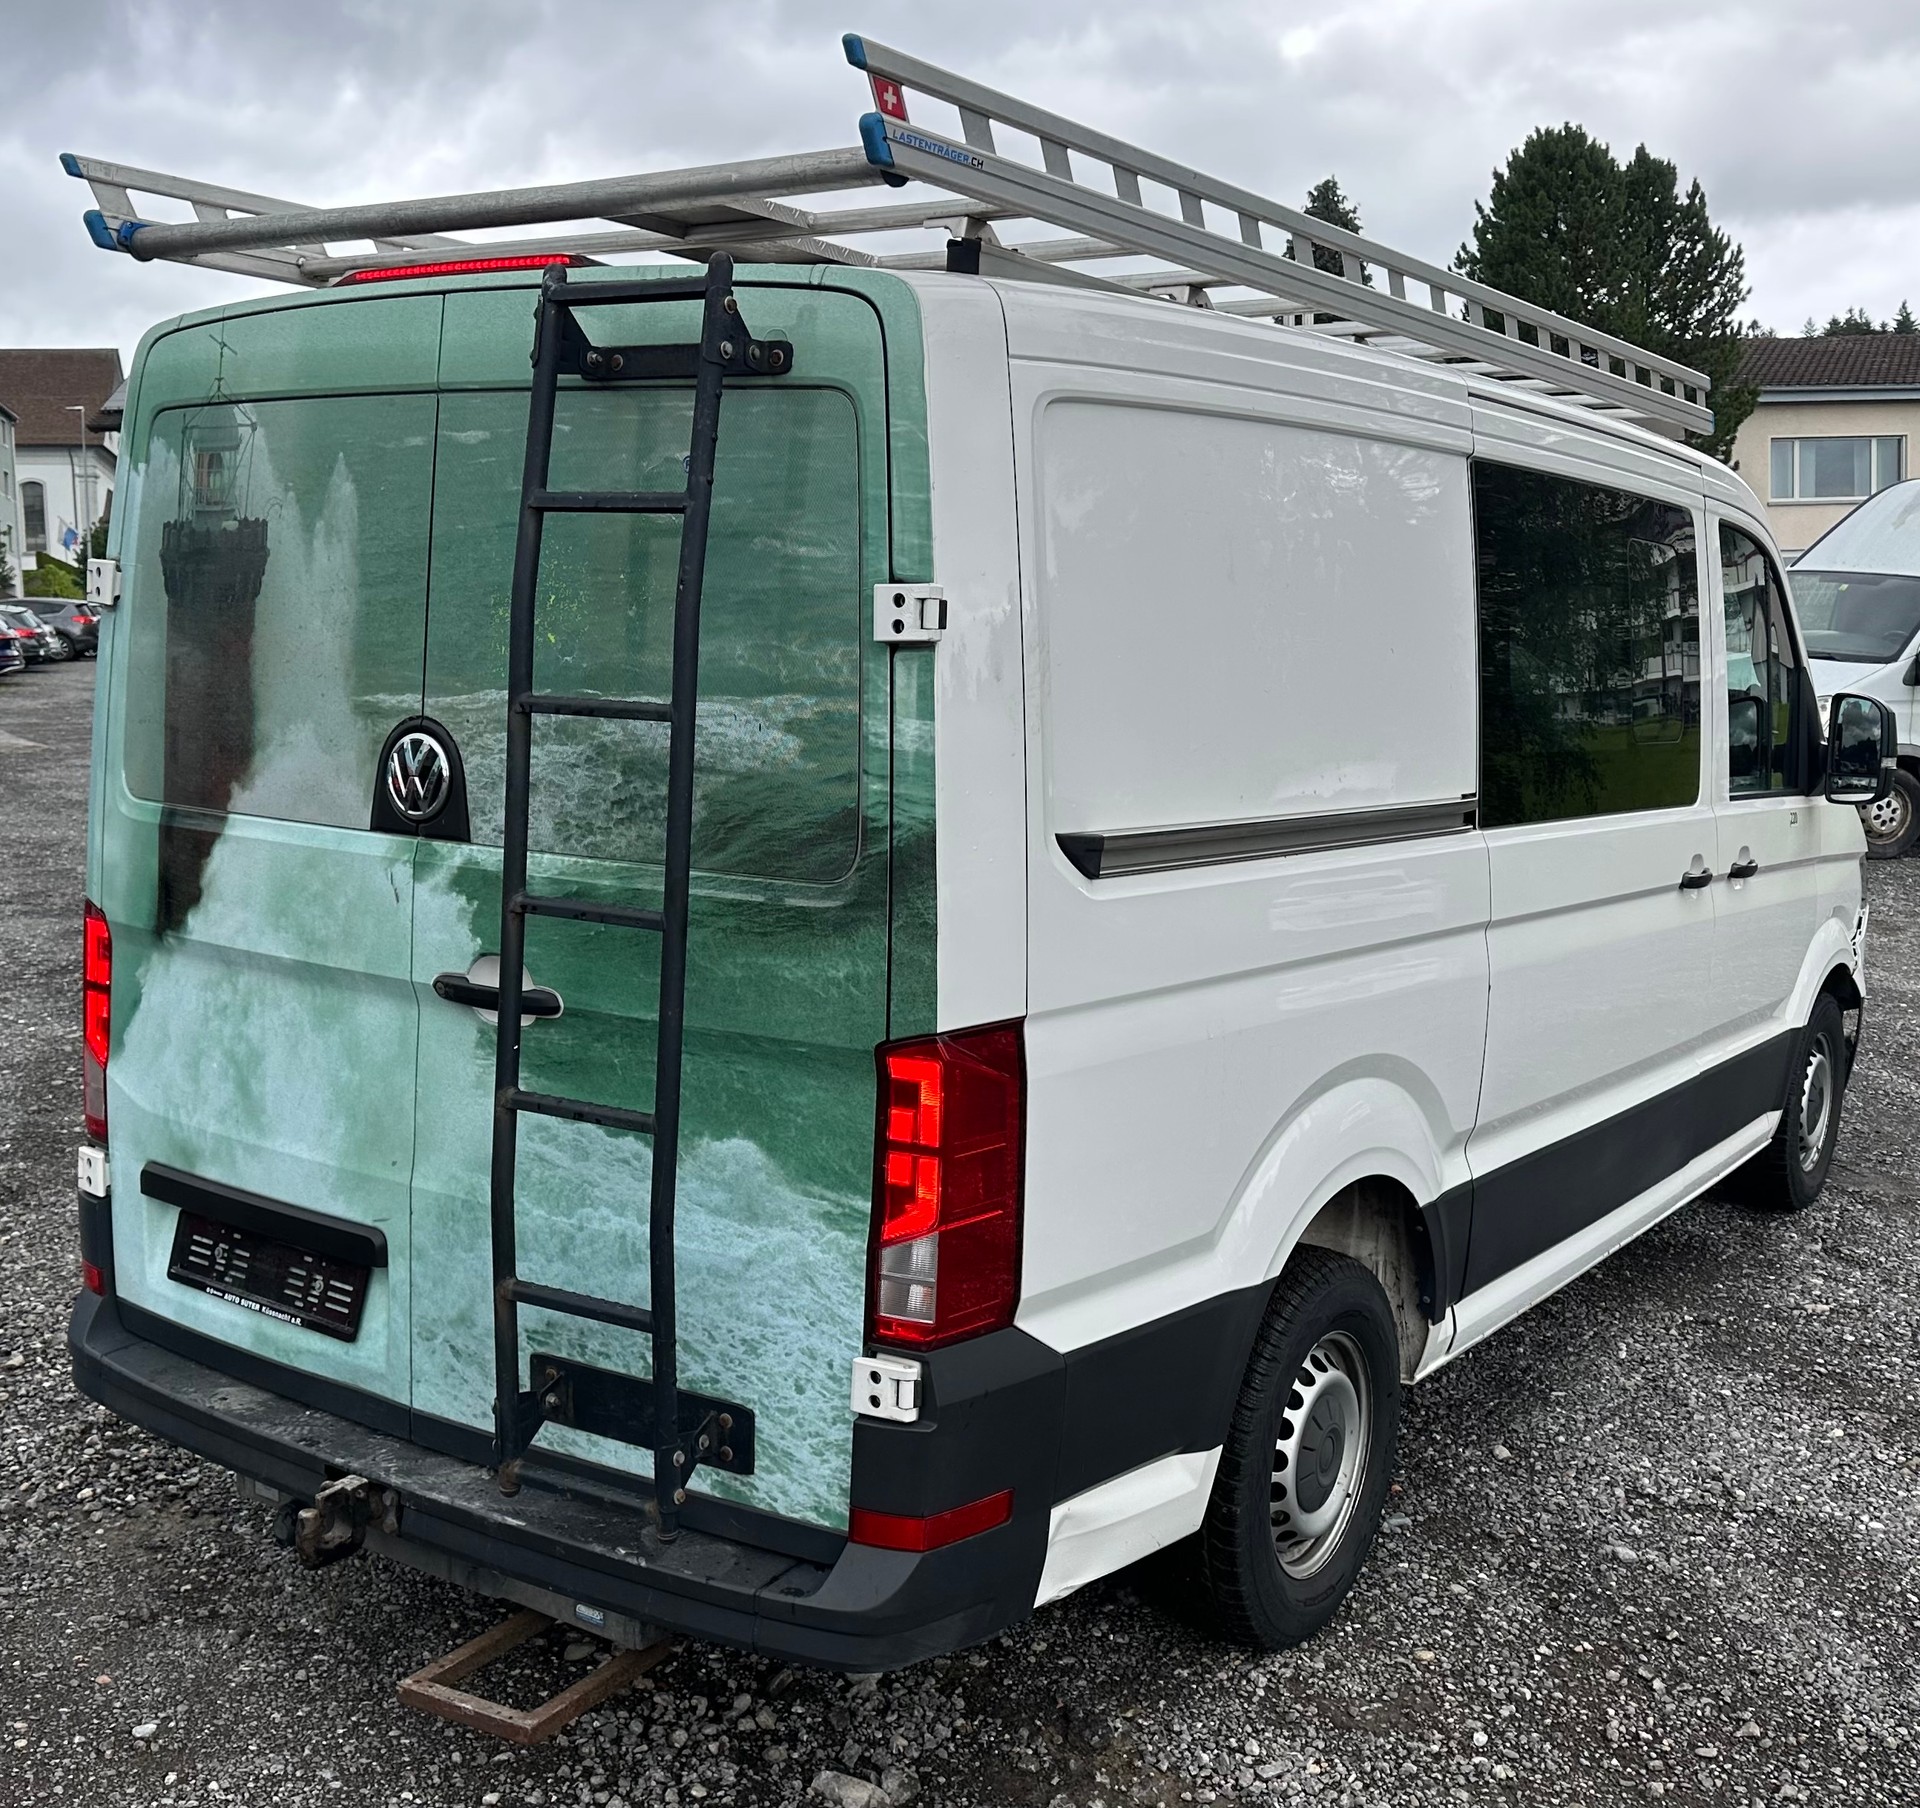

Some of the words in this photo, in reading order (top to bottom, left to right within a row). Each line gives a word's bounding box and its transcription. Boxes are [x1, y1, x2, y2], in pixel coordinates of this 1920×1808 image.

[893, 129, 984, 169] LASTENTRÄGER.CH
[224, 1293, 240, 1304] AUTO
[240, 1298, 260, 1312] SUTER
